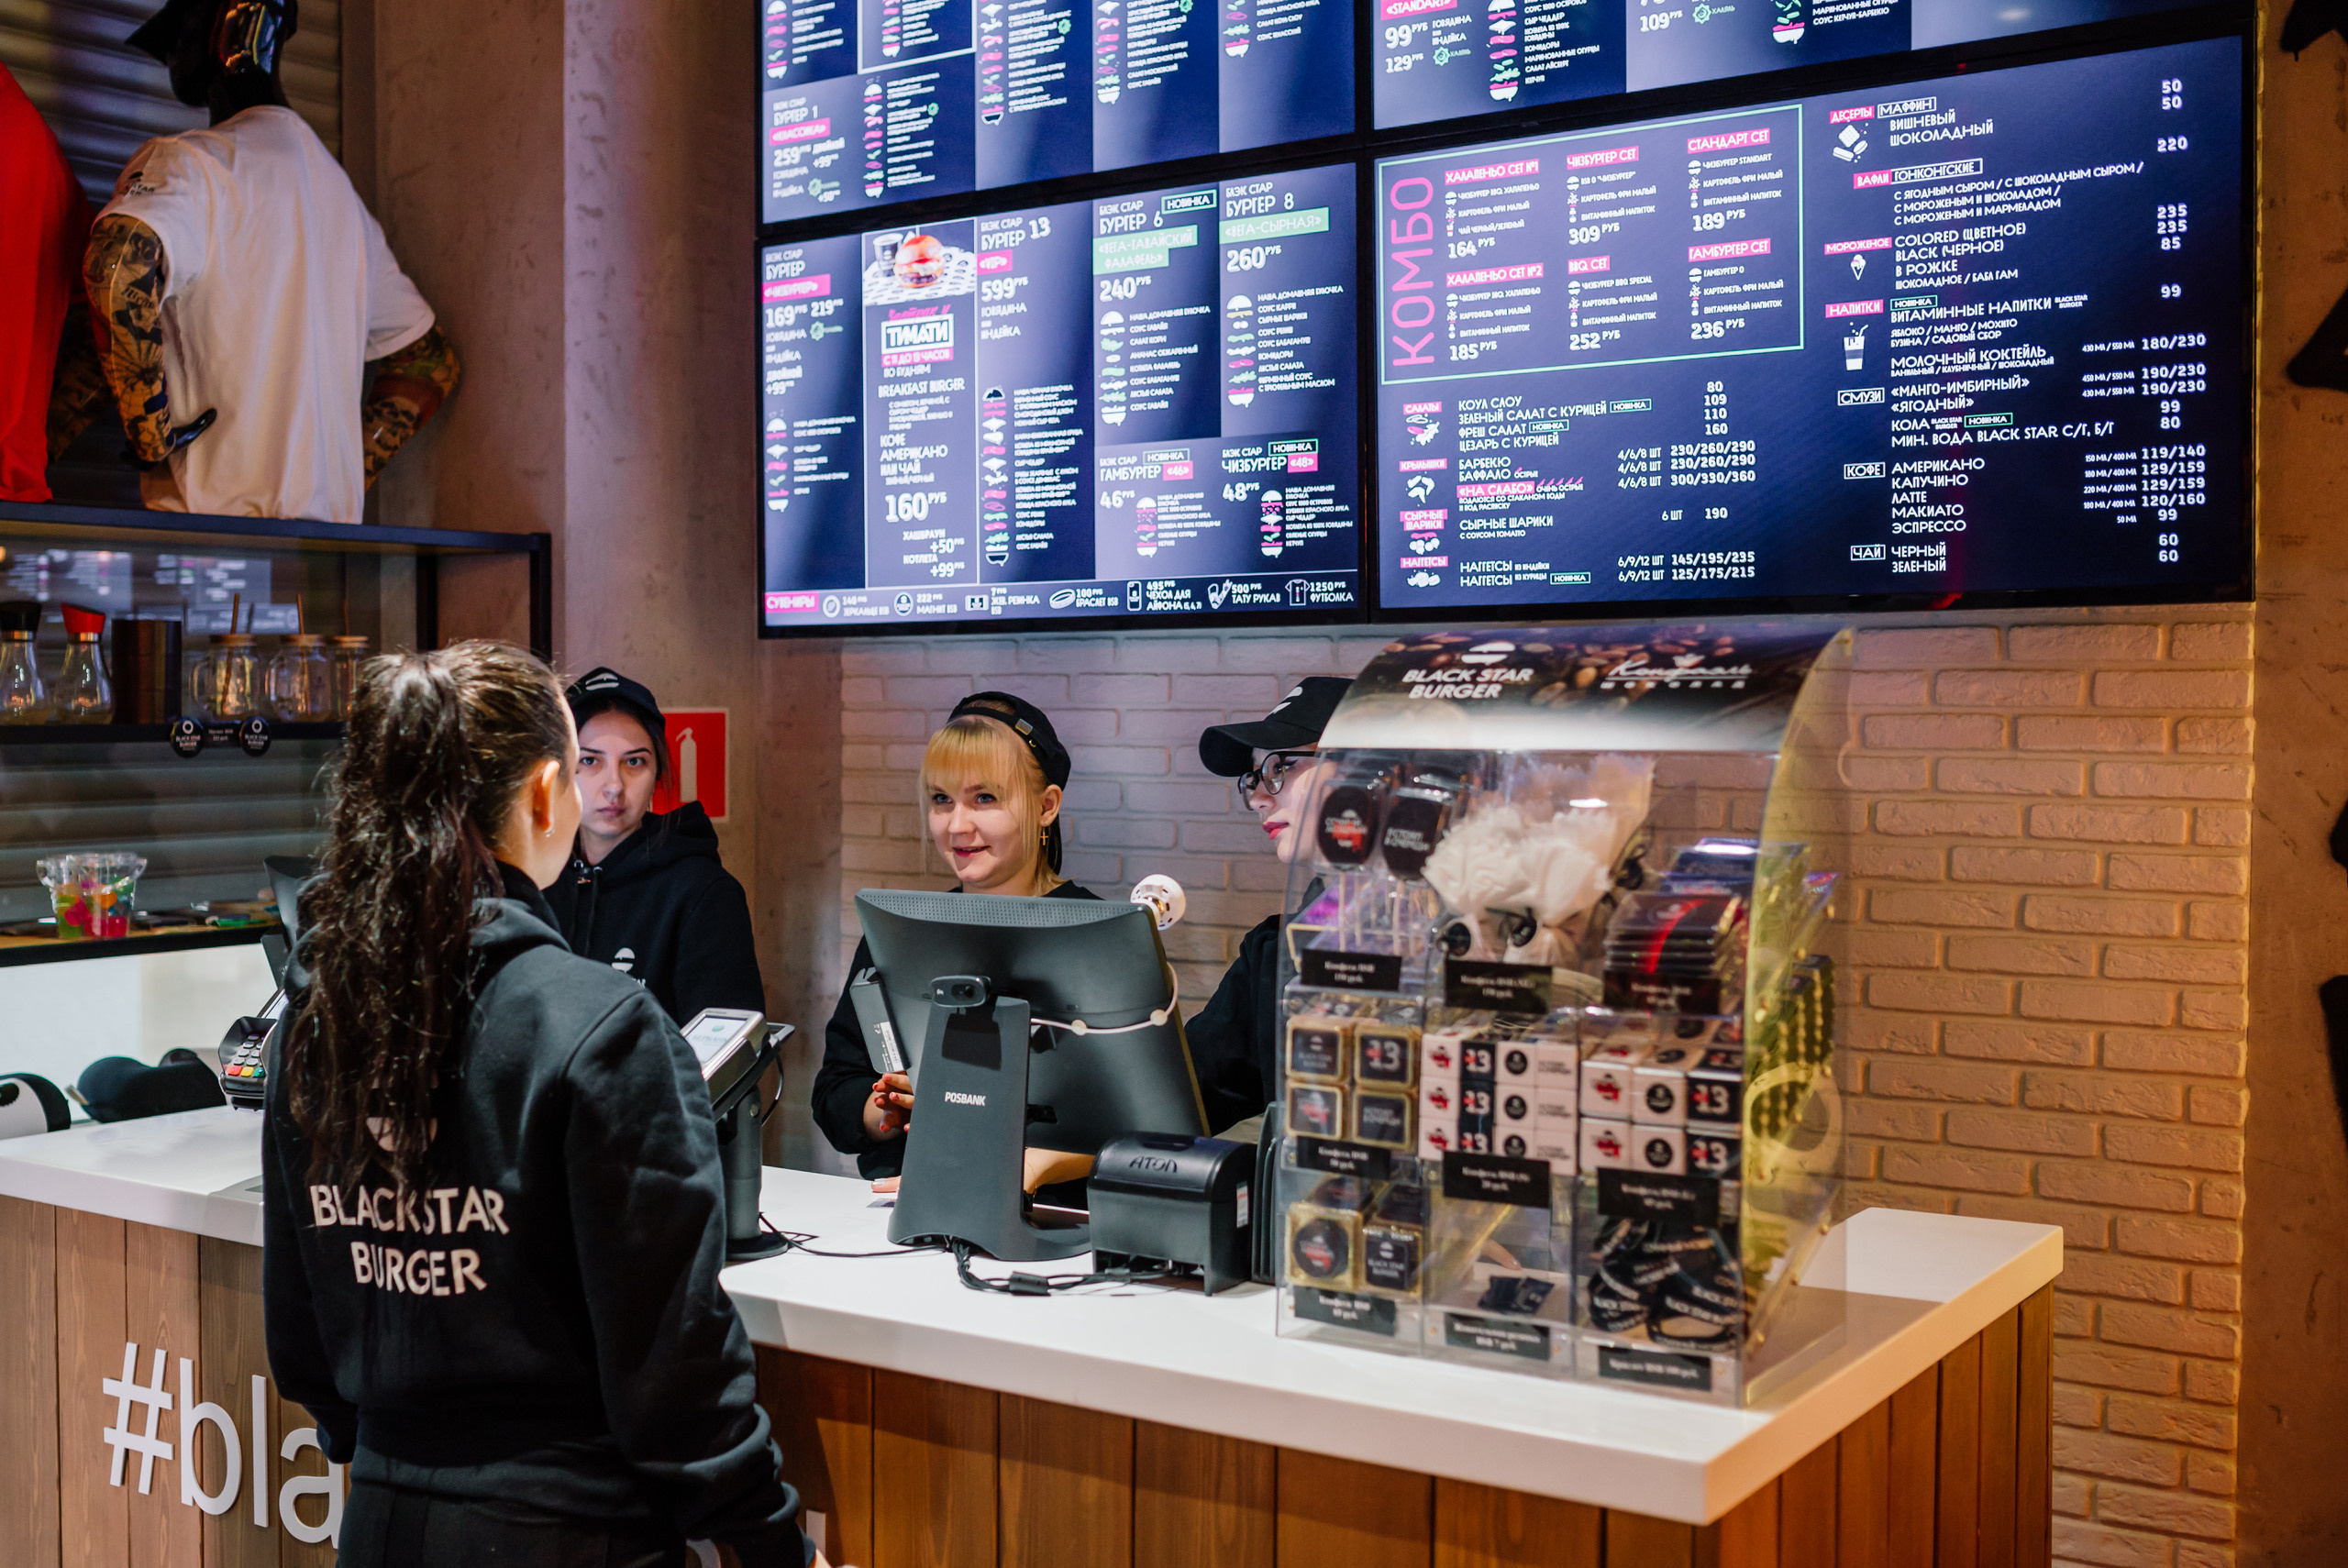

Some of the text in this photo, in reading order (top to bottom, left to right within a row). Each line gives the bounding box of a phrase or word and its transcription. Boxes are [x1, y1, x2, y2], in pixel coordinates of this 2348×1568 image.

[1384, 21, 1428, 49] 99 РУБ
[2162, 78, 2181, 94] 50
[1879, 99, 1932, 116] МАФФИН
[2162, 94, 2181, 109] 50
[1830, 106, 1871, 123] ДЕСЕРТЫ
[1889, 108, 1955, 131] ВИШНЕВЫЙ
[1688, 129, 1768, 150] СТАНДАРТ СЕТ
[1889, 118, 1993, 146] ШОКОЛАДНЫЙ
[2157, 136, 2187, 151] 220
[1567, 148, 1636, 167] ЧИЗБУРГЕР СЕТ
[1445, 160, 1538, 182] ХАЛАПЕНЬО СЕТ №1
[1857, 172, 1888, 186] ВАФЛИ
[1894, 161, 1975, 182] ГОНКОНГСКИЕ
[1225, 192, 1294, 217] БУРГЕР 8
[1893, 197, 2060, 226] С МОРОЖЕНЫМ И МАРМЕЛАДОМ
[2157, 204, 2187, 218] 235
[1029, 216, 1050, 239] 13
[1099, 210, 1163, 234] БУРГЕР 6
[1692, 208, 1745, 231] 189 РУБ
[1568, 222, 1620, 245] 309 РУБ
[1894, 222, 2025, 247] COLORED (ЦВЕТНОЕ)
[1447, 237, 1495, 259] 164 РУБ
[1689, 239, 1767, 259] ГАМБУРГЕР СЕТ
[1826, 237, 1888, 252] МОРОЖЕНОЕ
[1895, 239, 2003, 261] BLACK (ЧЕРНОЕ)
[2160, 236, 2180, 249] 85
[1226, 244, 1281, 272] 260 РУБ
[1390, 176, 1434, 366] КОМБО
[1895, 259, 1957, 277] В РОЖКЕ
[980, 277, 1017, 302] 599
[1099, 275, 1151, 302] 240 РУБ
[2161, 284, 2181, 297] 99
[1829, 301, 1879, 315] НАПИТКИ
[1890, 296, 2051, 323] ВИТАМИННЫЕ НАПИТКИ
[886, 322, 949, 347] ТИМАТИ
[1690, 317, 1744, 339] 236 РУБ
[1569, 329, 1620, 350] 252 РУБ
[2142, 334, 2206, 349] 180/230
[1449, 340, 1497, 360] 185 РУБ
[1890, 346, 2045, 369] МОЛОЧНЫЙ КОКТЕЙЛЬ
[2142, 363, 2206, 379] 190/230
[1706, 381, 1722, 392] 80
[1890, 376, 2029, 397] «МАНГО-ИМБИРНЫЙ»
[1458, 395, 1522, 411] КОУЛ СЛОУ
[1703, 393, 1726, 405] 109
[1839, 390, 1883, 404] СМУЗИ
[1890, 395, 1974, 413] «ЯГОДНЫЙ»
[1404, 403, 1439, 413] САЛАТЫ
[1458, 400, 1606, 425] ЗЕЛЕНЫЙ САЛАТ С КУРИЦЕЙ
[1704, 407, 1727, 420] 110
[2160, 400, 2180, 413] 99
[1705, 422, 1728, 435] 160
[1891, 417, 1930, 431] КОЛА
[2160, 415, 2180, 429] 80
[1457, 423, 1526, 438] ФРЕШ САЛАТ
[1932, 431, 1973, 445] ВОДА
[1977, 427, 2020, 442] BLACK
[2023, 425, 2058, 439] STAR
[2094, 421, 2114, 436] Б/Г
[1670, 439, 1755, 456] 230/260/290
[2142, 445, 2205, 459] 119/140
[1221, 456, 1287, 473] ЧИЗБУРГЕР
[1458, 456, 1511, 469] БАРБЕКЮ
[1845, 462, 1882, 478] КОФЕ
[1891, 457, 1985, 474] АМЕРИКАНО
[2141, 460, 2205, 475] 129/159
[1100, 464, 1161, 481] ГАМБУРГЕР
[1458, 468, 1511, 481] БАФФАЛО
[1670, 469, 1755, 486] 300/330/360
[1458, 482, 1533, 496] «НА СЛАБО»
[1891, 473, 1968, 489] КАПУЧИНО
[1100, 490, 1124, 508] 46
[1222, 481, 1248, 502] 48
[1891, 491, 1926, 503] ЛАТТЕ
[2141, 492, 2205, 506] 120/160
[884, 491, 947, 522] 160 РУБ
[1704, 506, 1727, 519] 190
[1891, 503, 1964, 518] МАКИАТО
[2157, 508, 2176, 521] 99
[1459, 515, 1553, 530] СЫРНЫЕ ШАРИКИ
[1891, 519, 1966, 534] ЭСПРЕССО
[2158, 534, 2178, 546] 60
[1671, 550, 1755, 566] 145/195/235
[1852, 544, 1883, 559] ЧАЙ
[1890, 542, 1945, 558] ЧЕРНЫЙ
[2158, 549, 2178, 561] 60
[1402, 557, 1445, 567] НАГГЕТСЫ
[1460, 559, 1512, 572] НАГГЕТСЫ
[1891, 558, 1945, 572] ЗЕЛЕНЫЙ
[1671, 566, 1755, 580] 125/175/215
[1309, 581, 1334, 591] 1250
[1401, 668, 1534, 682] BLACK STAR
[1407, 683, 1501, 700] BURGER
[945, 1091, 985, 1105] POSBANK
[310, 1184, 510, 1235] BLACK STAR
[350, 1241, 488, 1297] BURGER
